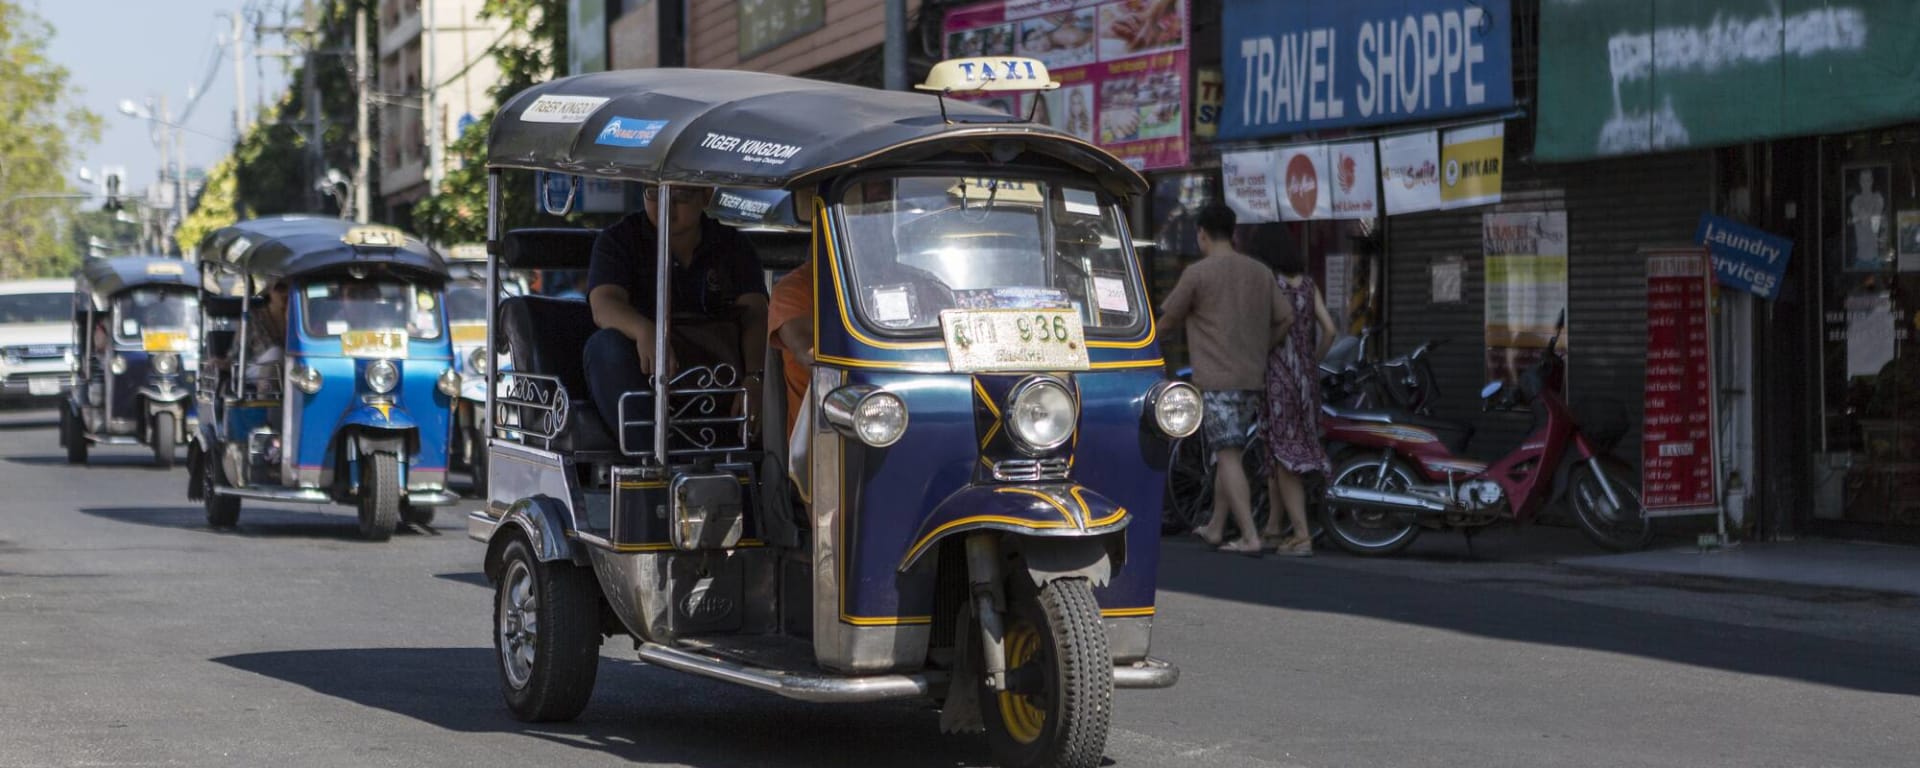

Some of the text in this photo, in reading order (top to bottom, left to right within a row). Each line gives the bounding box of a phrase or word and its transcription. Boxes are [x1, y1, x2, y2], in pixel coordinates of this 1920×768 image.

[959, 61, 1037, 81] TAXI
[1241, 27, 1344, 126] TRAVEL
[1356, 7, 1486, 118] SHOPPE
[701, 132, 802, 159] TIGER KINGDOM
[1462, 157, 1499, 178] NOK AIR
[719, 192, 741, 208] TIGER
[1706, 222, 1781, 264] Laundry
[1711, 255, 1777, 289] ervices
[1017, 315, 1068, 344] 936
